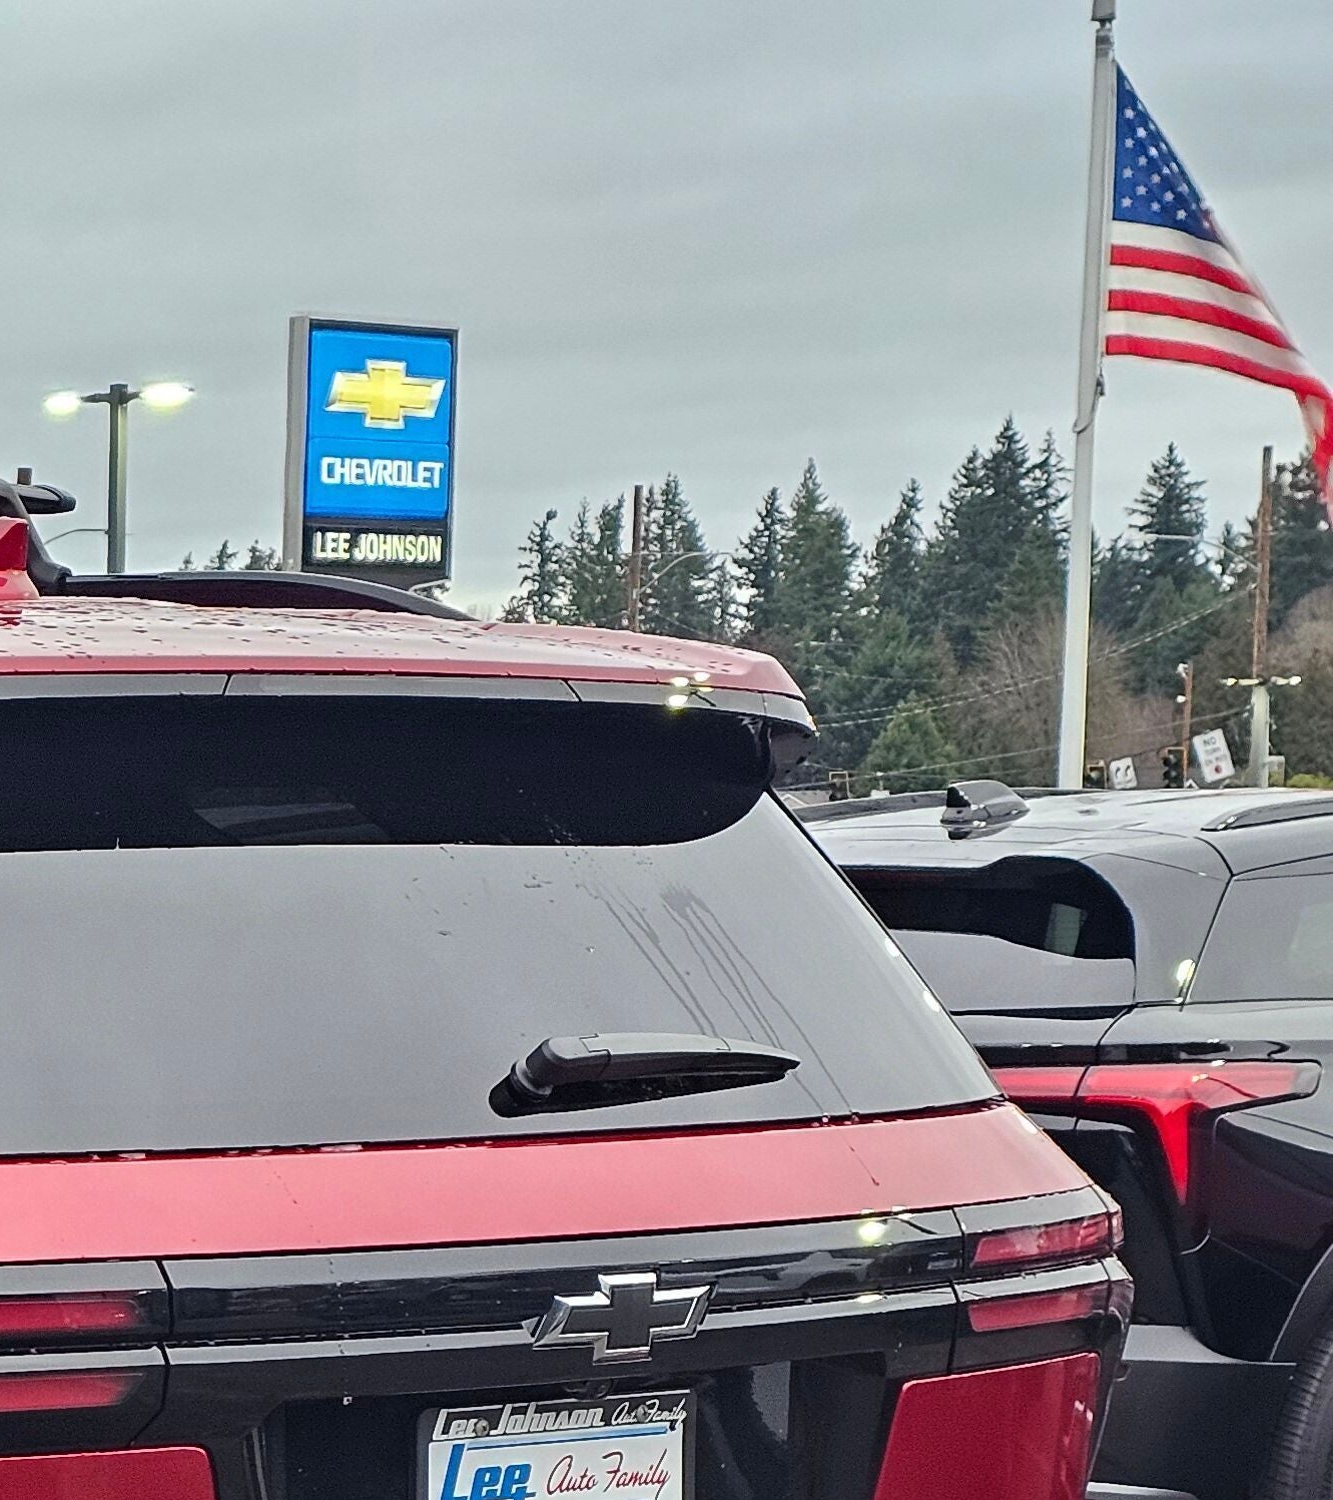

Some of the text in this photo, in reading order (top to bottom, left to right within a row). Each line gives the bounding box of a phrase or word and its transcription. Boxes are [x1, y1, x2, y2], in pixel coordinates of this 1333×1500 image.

[320, 457, 444, 488] CHEVROLET
[313, 531, 442, 563] LEE JOHNSON
[489, 1402, 605, 1435] Johnson
[611, 1401, 639, 1425] Aut
[646, 1397, 688, 1428] Family
[547, 1455, 598, 1495] Auto
[603, 1449, 671, 1500] Family
